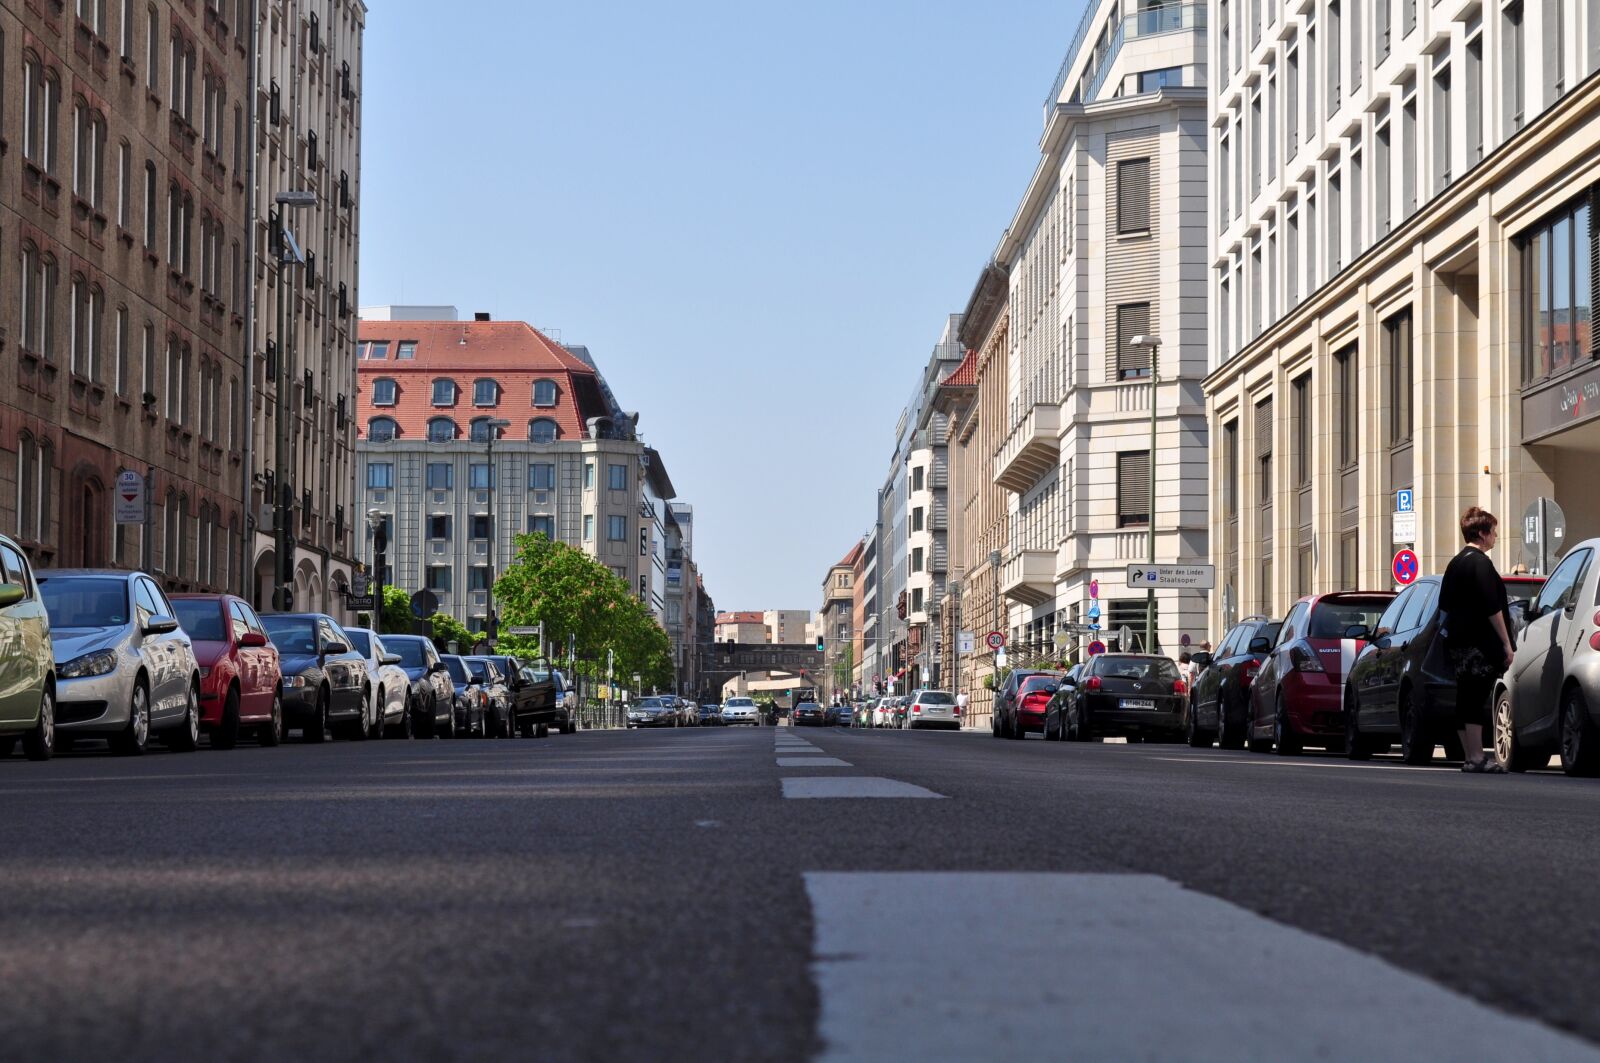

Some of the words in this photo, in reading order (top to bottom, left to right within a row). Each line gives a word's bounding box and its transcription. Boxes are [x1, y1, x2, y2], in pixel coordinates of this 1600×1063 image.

[124, 473, 134, 481] 30
[1400, 492, 1409, 509] P
[1160, 568, 1173, 576] Unter
[1175, 568, 1185, 576] den
[1160, 576, 1197, 584] Staatsoper
[990, 635, 1001, 645] 30
